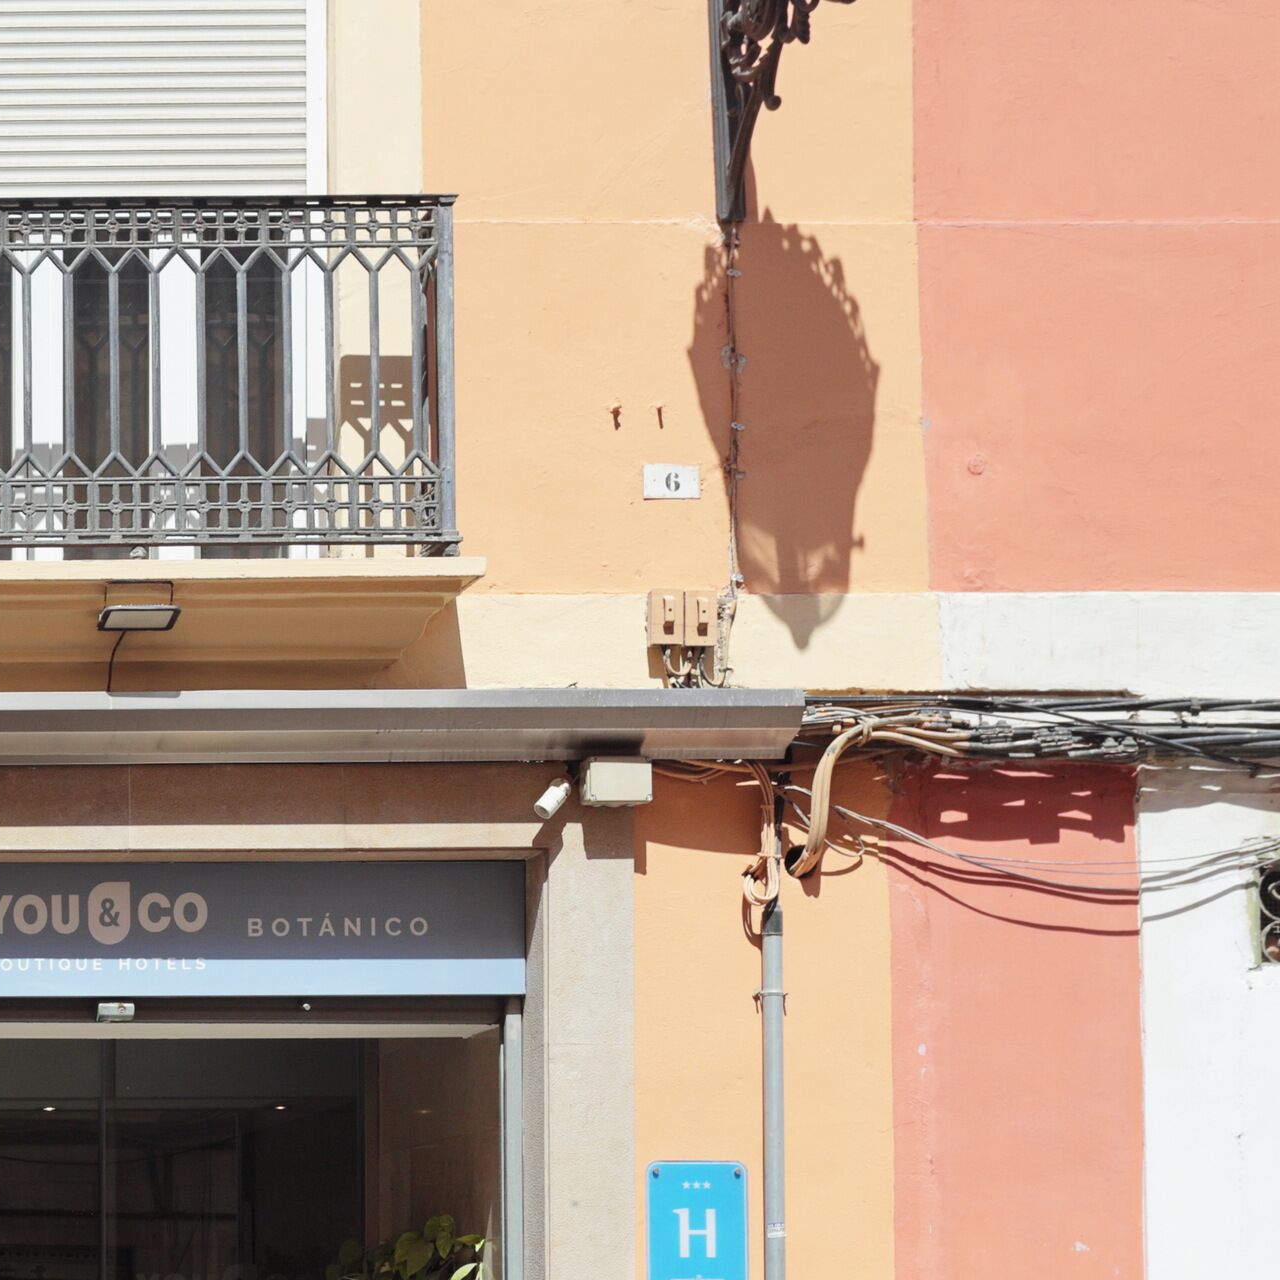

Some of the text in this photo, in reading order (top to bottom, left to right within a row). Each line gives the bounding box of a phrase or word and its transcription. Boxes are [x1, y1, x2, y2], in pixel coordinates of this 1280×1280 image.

[665, 472, 680, 492] 6
[246, 912, 430, 938] BOTÁNICO
[118, 957, 208, 972] HOTELS
[672, 1207, 716, 1258] H
